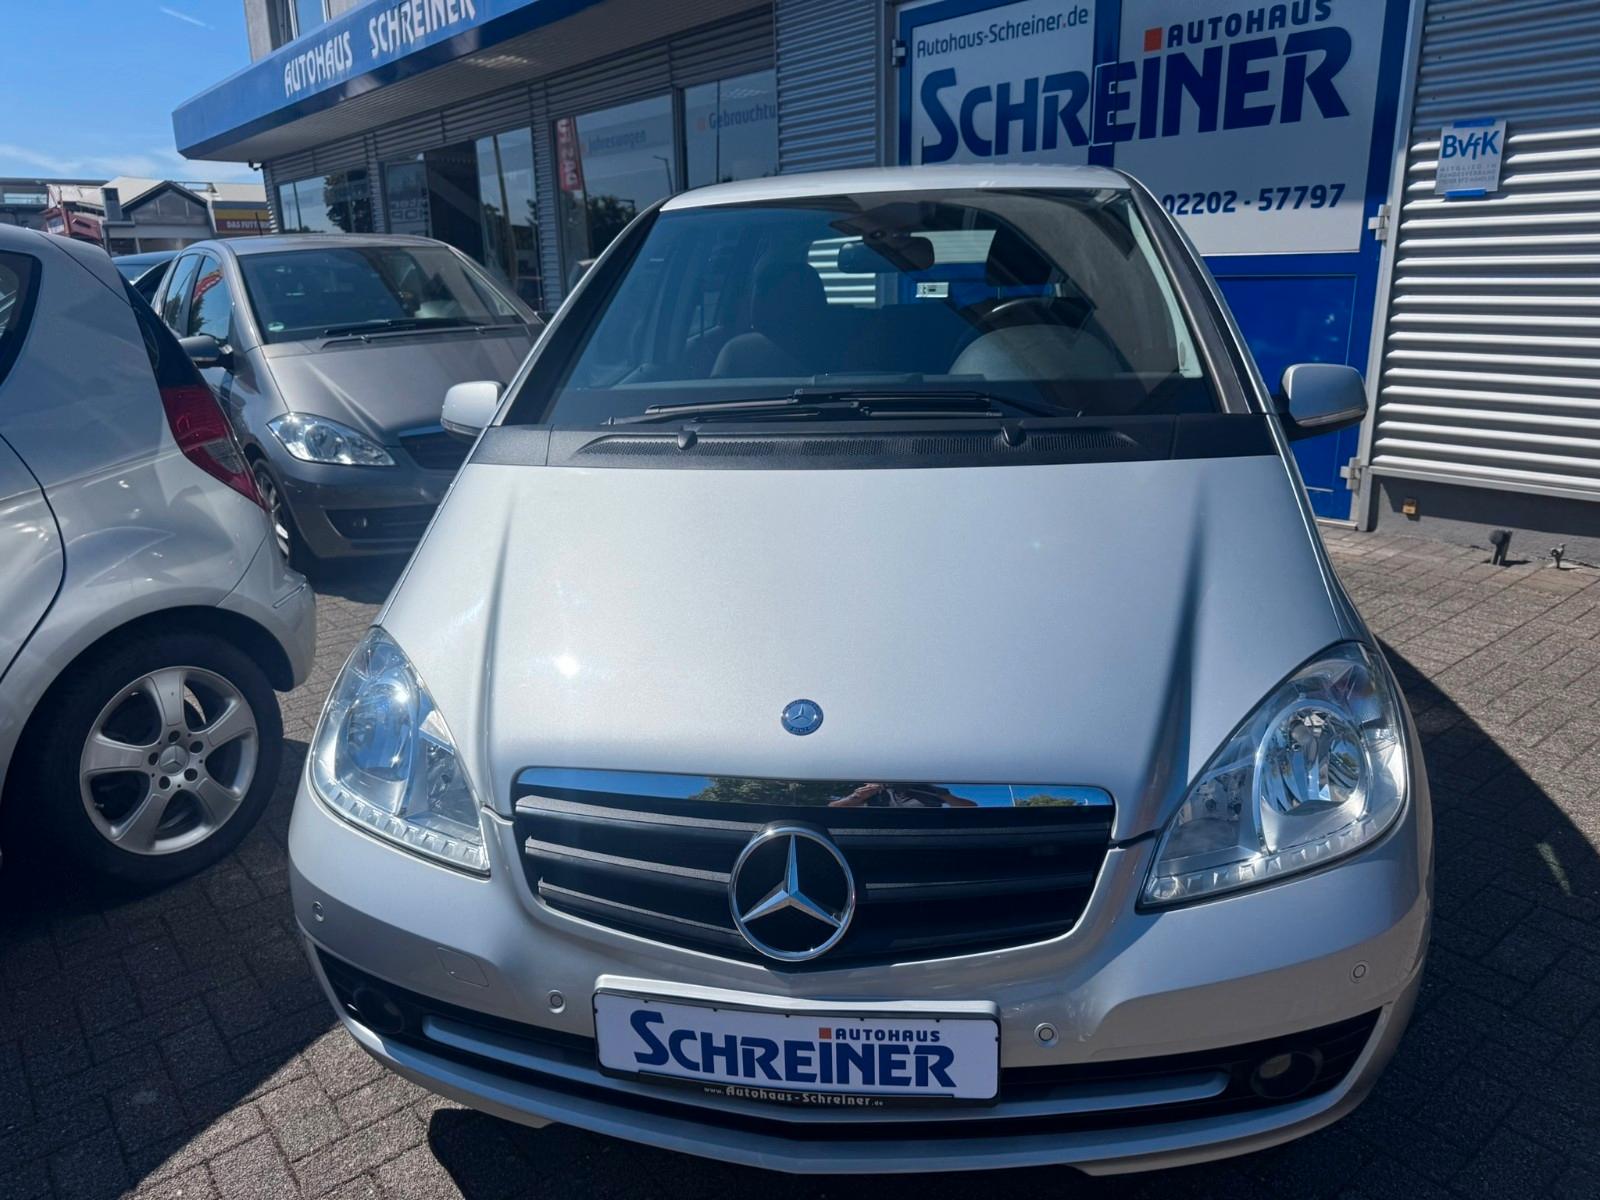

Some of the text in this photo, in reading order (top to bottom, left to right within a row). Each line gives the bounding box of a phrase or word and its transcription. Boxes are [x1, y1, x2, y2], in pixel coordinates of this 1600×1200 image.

[284, 0, 476, 98] AUTOHAUS SCHREINER
[917, 5, 1089, 58] Autohaus-Schreiner.de
[1167, 0, 1332, 48] AUTOHAUS
[920, 26, 1352, 166] SCHREINER
[1442, 130, 1499, 160] BvfK
[1161, 190, 1237, 215] 02202
[1258, 184, 1346, 211] 57797
[630, 1009, 958, 1088] SCHREINER
[835, 1027, 941, 1042] AUTOHAUS
